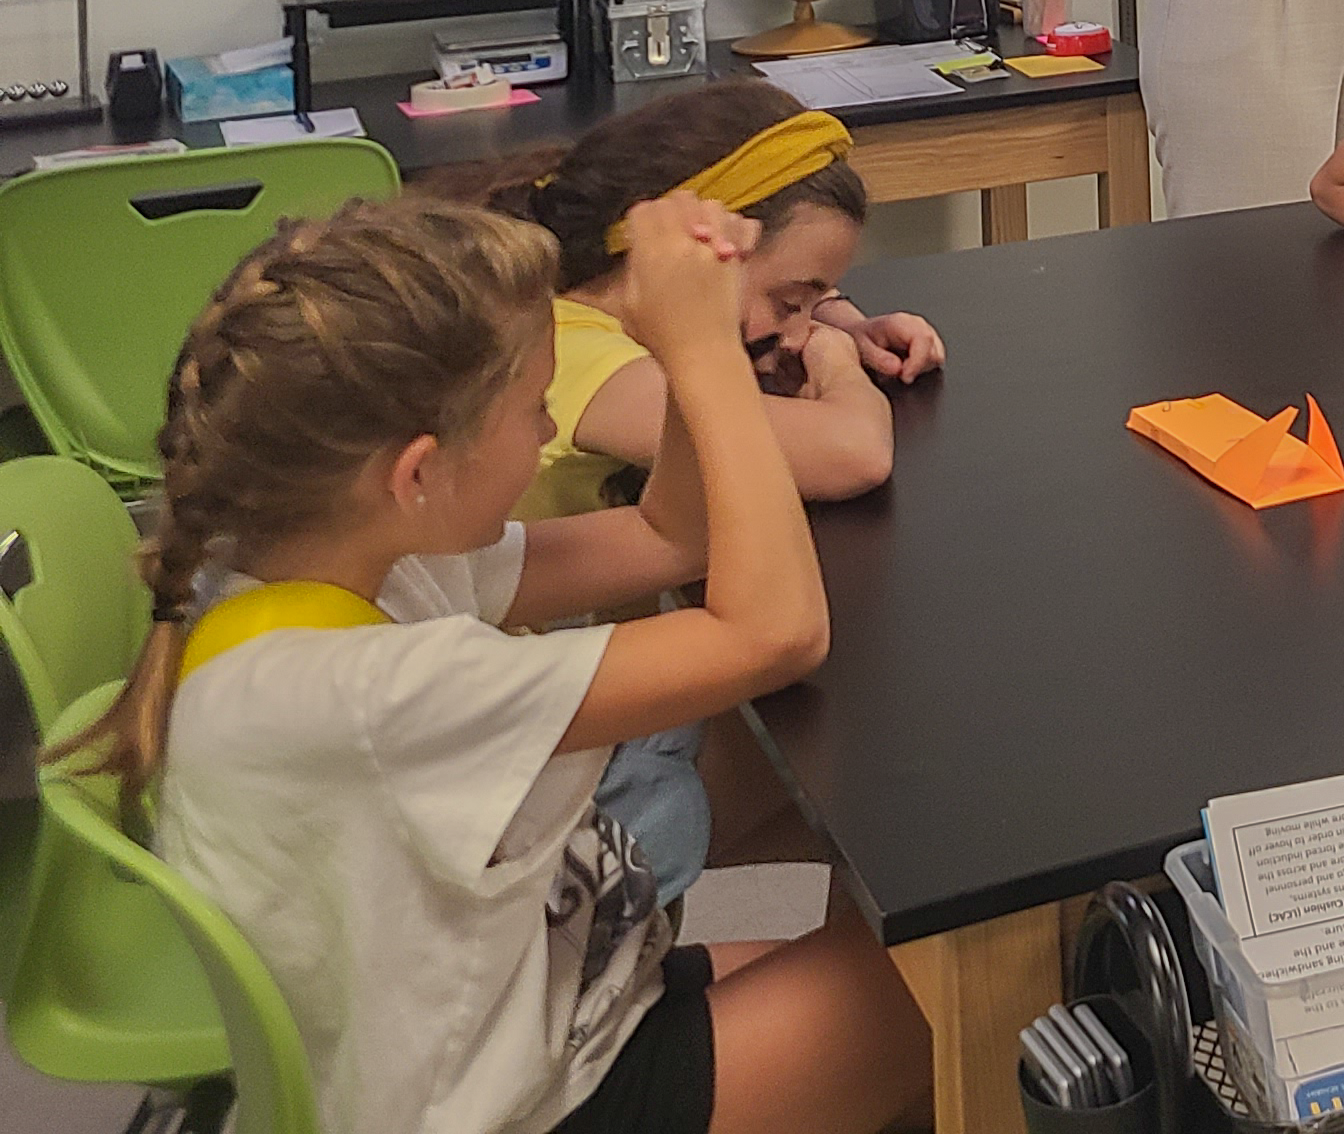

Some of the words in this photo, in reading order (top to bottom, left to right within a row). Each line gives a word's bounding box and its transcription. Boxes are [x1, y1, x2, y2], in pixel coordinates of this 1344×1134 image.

[1317, 871, 1334, 882] and
[1265, 875, 1313, 895] personnel
[1304, 899, 1343, 913] Cushion
